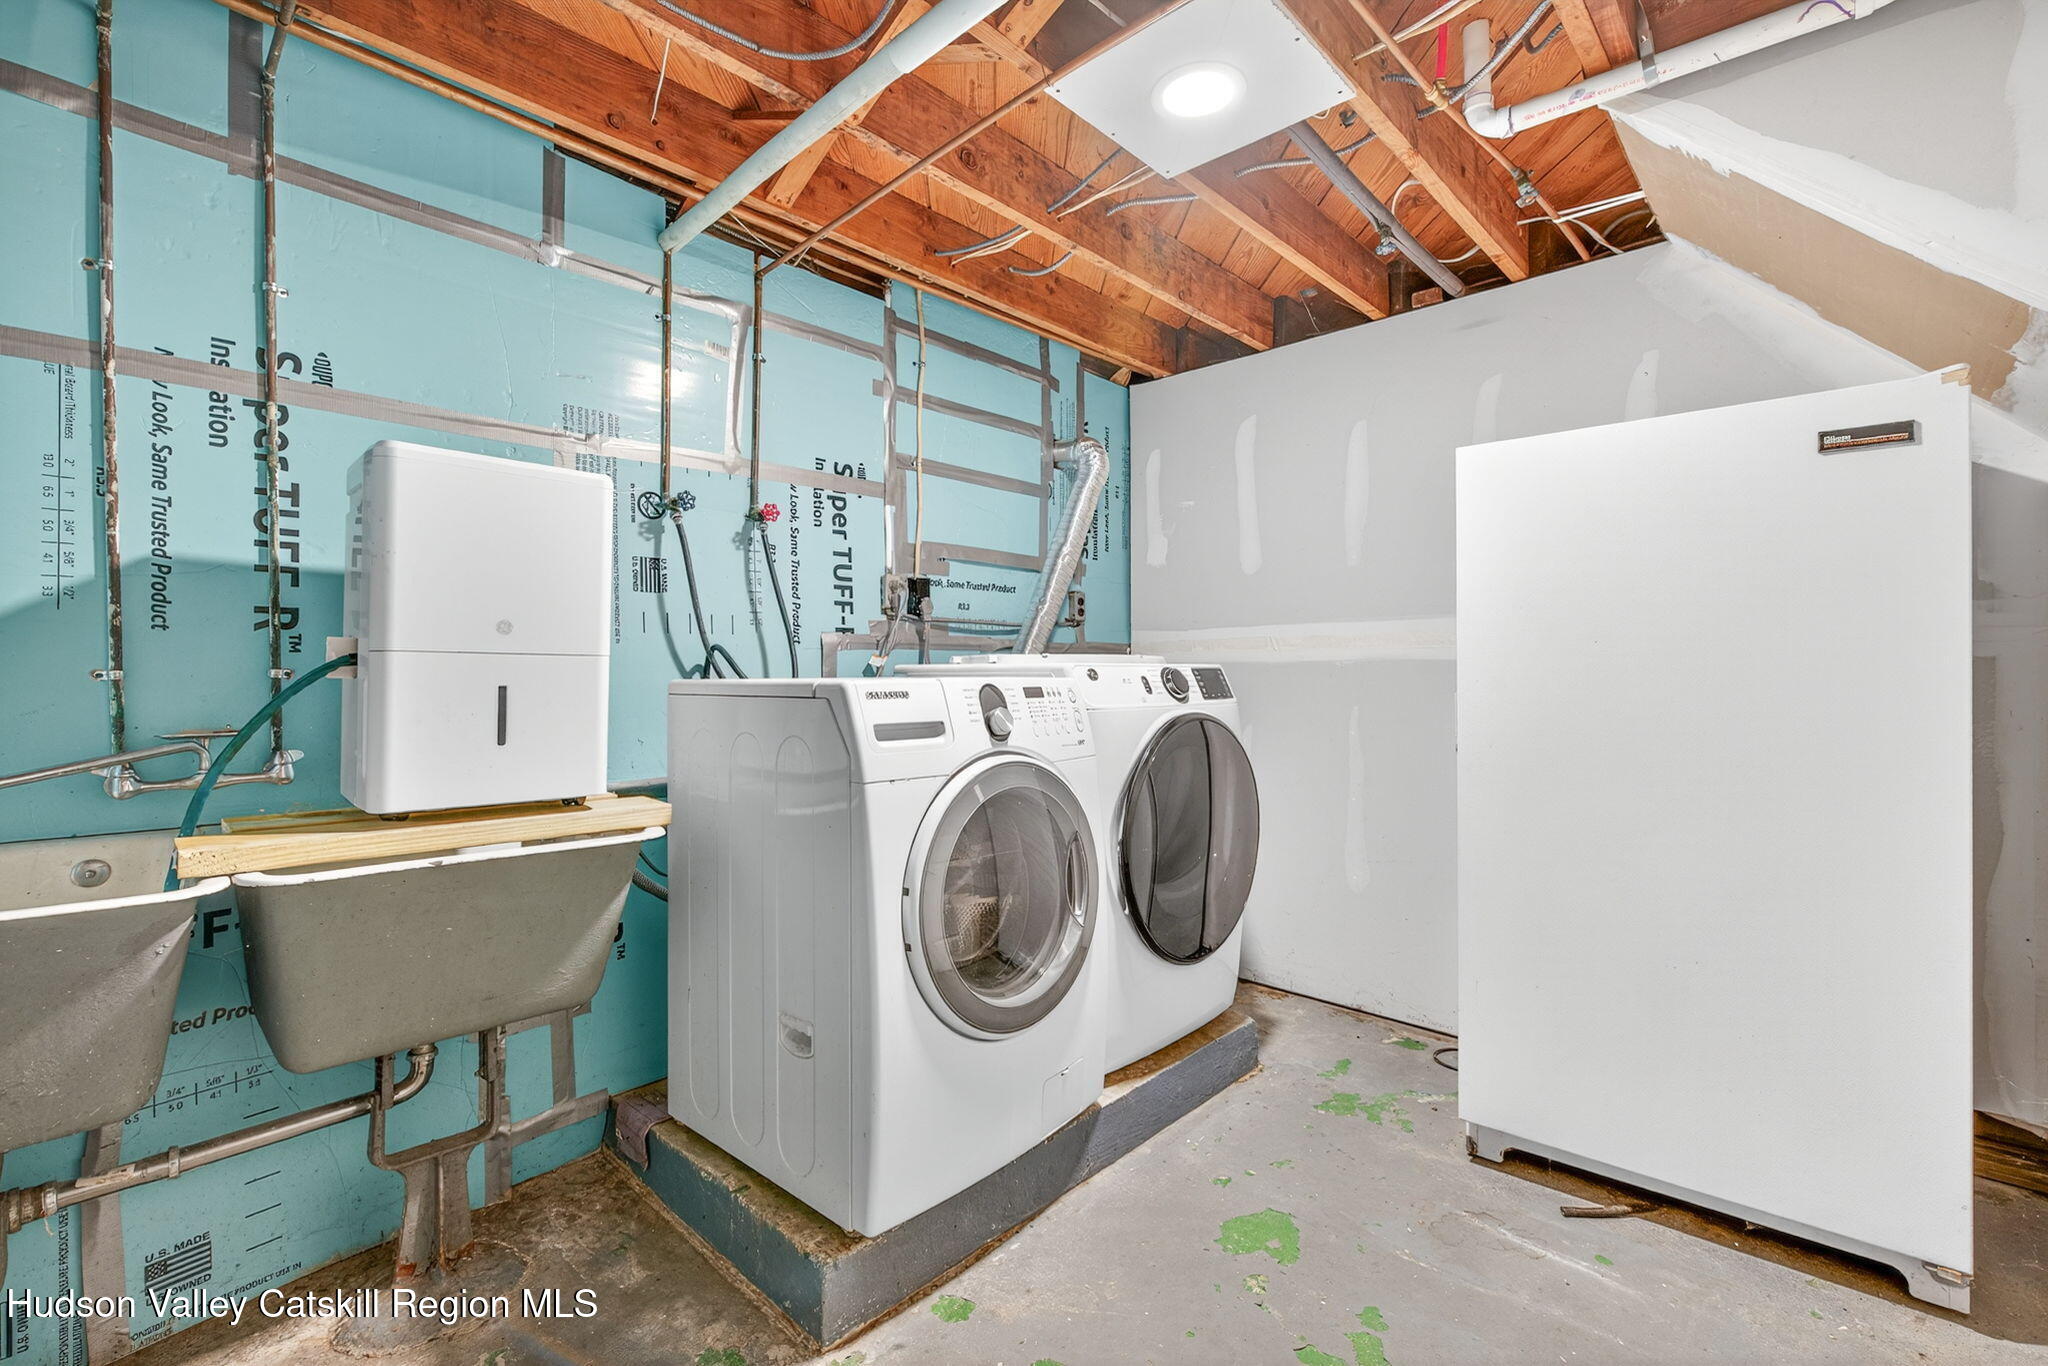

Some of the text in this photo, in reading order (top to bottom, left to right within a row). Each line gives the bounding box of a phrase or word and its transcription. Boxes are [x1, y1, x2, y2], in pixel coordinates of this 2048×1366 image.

[148, 391, 173, 438] Look,
[208, 336, 236, 448] Insation
[242, 346, 302, 472] Sper
[151, 442, 172, 491] Same
[813, 457, 827, 528] Inlation
[151, 495, 172, 558] Trusted
[827, 462, 854, 541] Sper
[150, 563, 173, 631] Product
[790, 560, 801, 600] Trusted
[791, 602, 802, 645] Product
[144, 1230, 212, 1265] U.S. MADE
[171, 1273, 213, 1298] OWNED
